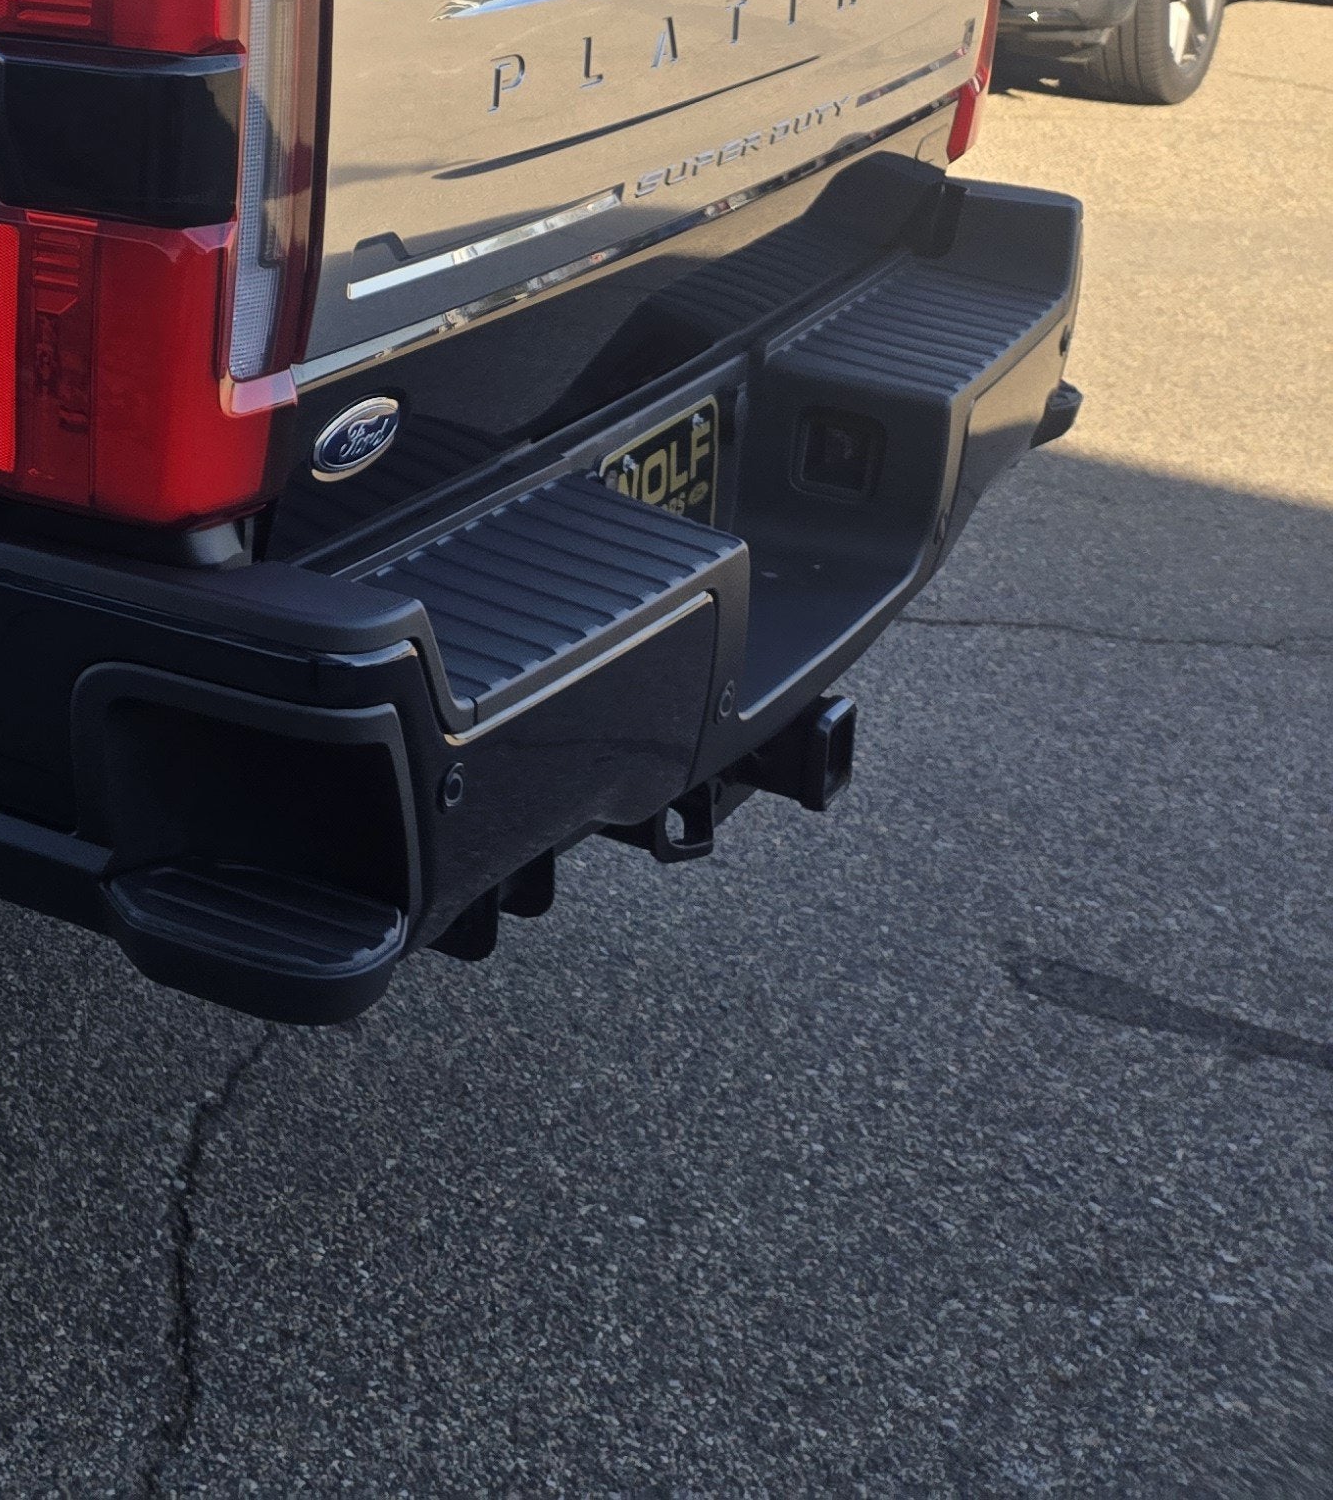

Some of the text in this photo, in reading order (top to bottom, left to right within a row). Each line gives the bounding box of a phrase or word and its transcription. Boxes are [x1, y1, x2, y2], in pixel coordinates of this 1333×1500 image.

[634, 94, 851, 198] SUPER DUTY
[340, 415, 389, 457] Ford
